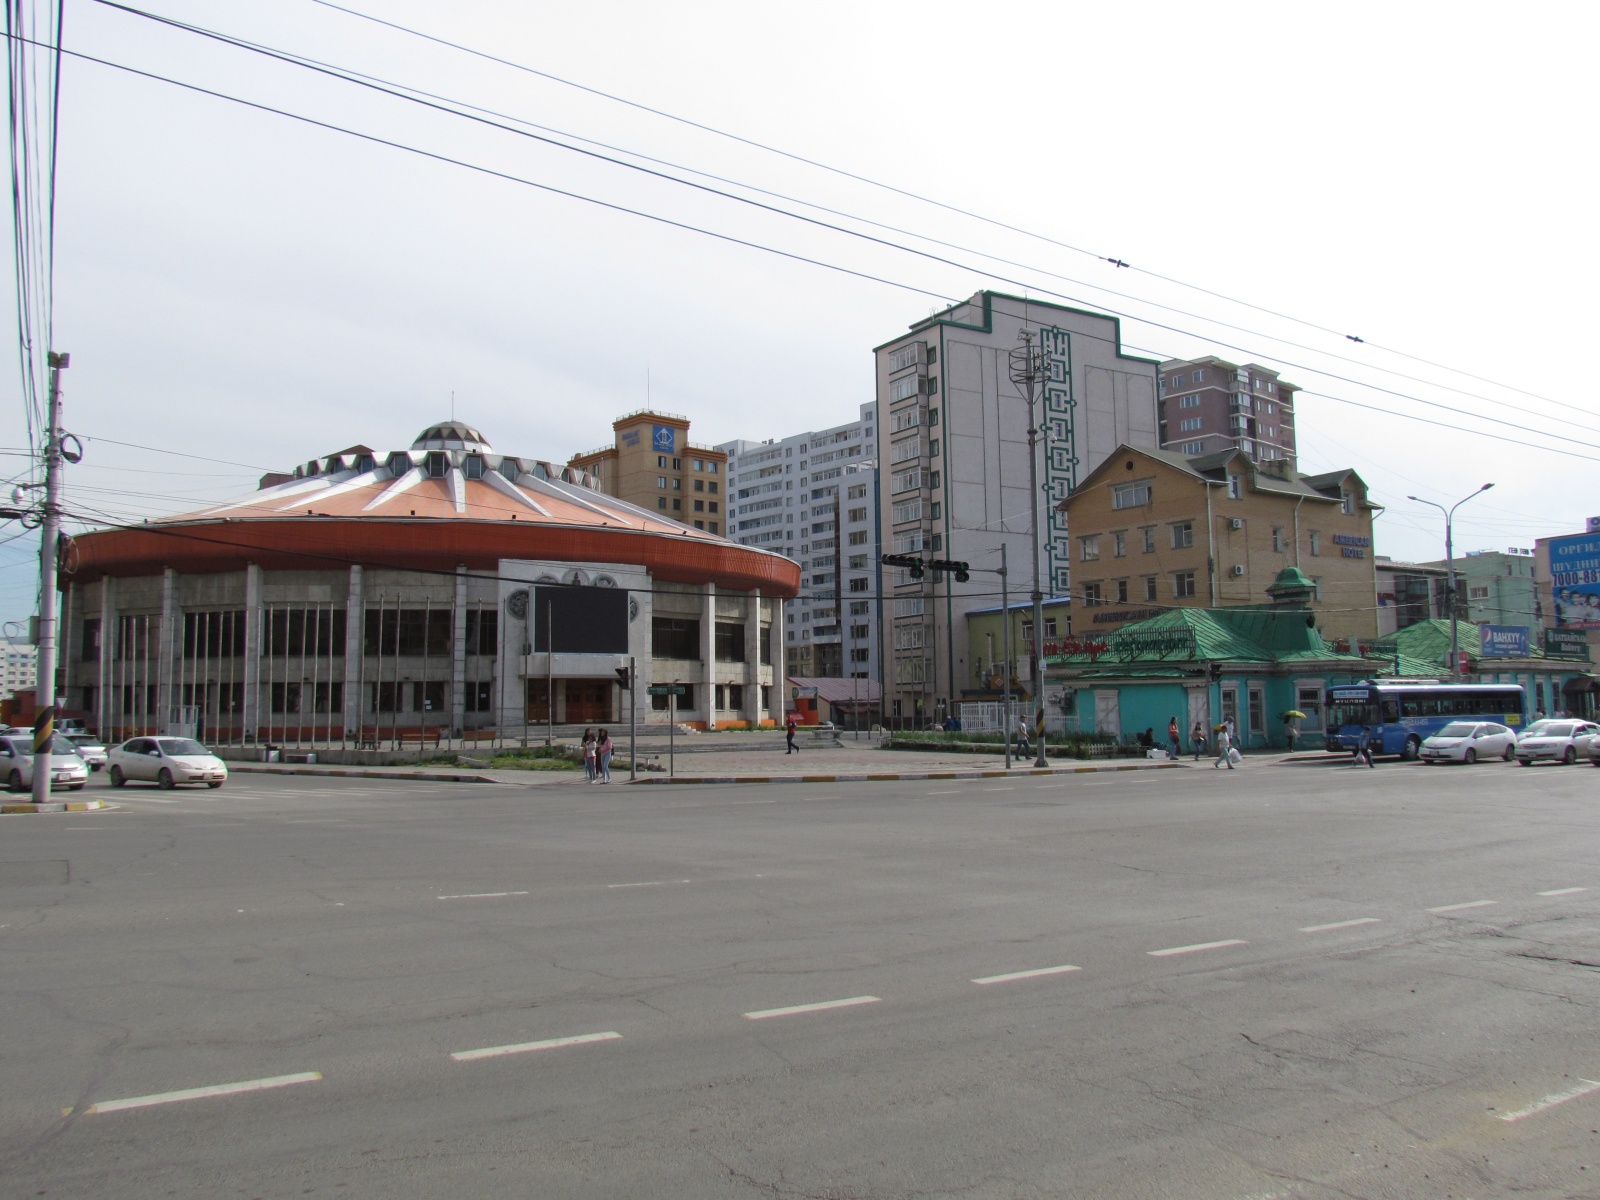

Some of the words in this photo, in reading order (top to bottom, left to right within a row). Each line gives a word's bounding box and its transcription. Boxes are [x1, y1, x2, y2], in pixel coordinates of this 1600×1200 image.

[1333, 534, 1370, 547] AMERICAN
[1342, 547, 1365, 559] HOTEL
[1093, 609, 1147, 624] AMERICAN
